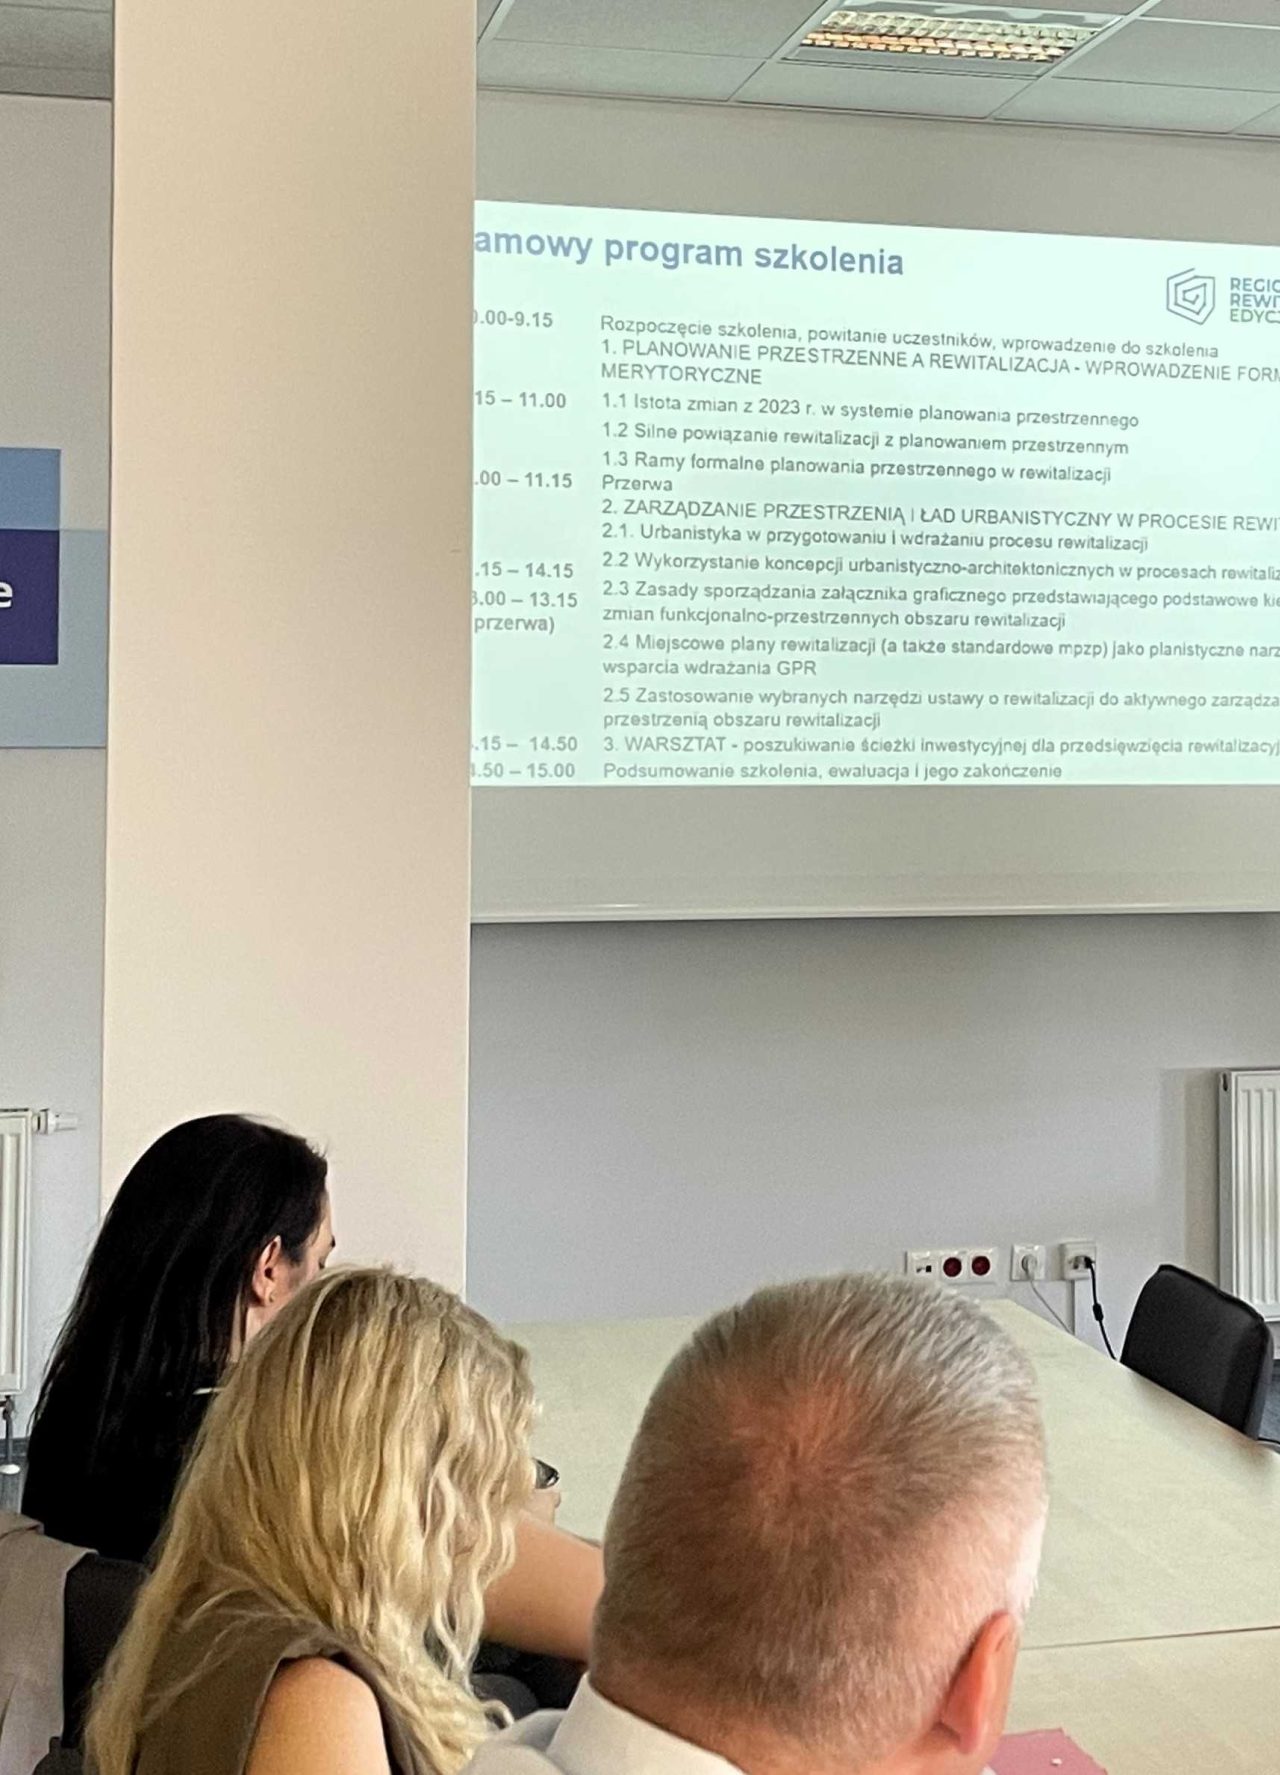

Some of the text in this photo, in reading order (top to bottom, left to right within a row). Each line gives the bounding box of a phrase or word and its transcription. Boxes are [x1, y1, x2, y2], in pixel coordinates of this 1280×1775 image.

[475, 232, 904, 276] amowy program szkolenia
[600, 316, 1219, 359] Rozpoczęcie szkolenia, powitanie uczestników, wprowadzenie do szkolenia
[602, 340, 617, 356] 1.
[622, 340, 751, 361] PLANOWANIE
[757, 346, 908, 368] PRZESTRZENNE
[911, 352, 925, 368] A
[929, 353, 1071, 374] REWITALIZACJA
[1085, 360, 1231, 381] WPROWADZENIE
[601, 363, 762, 385] MERYTORYCZNE
[519, 391, 567, 409] 11.00
[603, 393, 1139, 430] 1.1 Istota zmian z 2023 r. w systemie planowania przestrzennego
[603, 422, 1129, 458] 1.2 Silne powiązanie rewitalizacji z planowaniem przestrzennym
[603, 451, 1111, 485] 1.3 Ramy formalne planowania przestrzennego w rewitalizacji
[524, 471, 573, 489] 11.15
[602, 475, 673, 492] Przerwa
[601, 499, 617, 515] 2.
[623, 500, 757, 520] ZARZĄDZANIE
[763, 503, 906, 525] PRZESTRZENIĄ
[910, 507, 915, 523] I
[919, 507, 956, 524] ŁAD
[961, 508, 1113, 528] URBANISTYCZNY
[1116, 512, 1134, 528] W
[1138, 513, 1227, 531] PROCESIE
[602, 522, 634, 538] 2.1.
[640, 523, 742, 544] Urbanistyka
[746, 529, 761, 542] w
[766, 528, 887, 546] przygotowaniu
[900, 530, 984, 548] wdrażaniu
[988, 535, 1053, 551] procesu
[1057, 534, 1149, 554] rewitalizacji
[525, 562, 574, 578] 14.15
[602, 552, 629, 568] 2.2
[634, 552, 760, 572] Wykorzystanie
[764, 555, 844, 575] koncepcji
[848, 557, 1115, 580] urbanistyczno-architektonicznych
[1118, 565, 1133, 578] w
[1136, 564, 1217, 581] procesach
[529, 591, 578, 609] 13.15
[602, 581, 630, 597] 2.3
[635, 581, 699, 601] Zasady
[703, 583, 816, 602] sporządzania
[821, 585, 908, 604] załącznika
[912, 586, 1007, 606] graficznego
[1012, 588, 1159, 609] przedstawiającego
[1162, 591, 1259, 609] podstawowe
[474, 616, 556, 635] przerwa)
[602, 605, 1066, 631] zmian funkcjonalno-przestrzennych obszaru rewitalizacji
[603, 634, 629, 649] 2.4
[635, 634, 725, 653] Miejscowe
[730, 635, 776, 654] plany
[780, 636, 876, 656] rewitalizacji
[880, 637, 898, 656] (a
[902, 638, 946, 654] także
[951, 639, 1054, 655] standardowe
[1058, 640, 1108, 659] mpzp)
[1112, 640, 1145, 659] jako
[1149, 641, 1245, 660] planistyczne
[602, 658, 817, 677] wsparcia wdrażania GPR
[603, 687, 630, 703] 2.5
[635, 687, 754, 704] Zastosowanie
[758, 688, 848, 707] wybranych
[853, 689, 923, 708] narzędzi
[927, 690, 985, 708] ustawy
[988, 693, 1000, 705] o
[1003, 690, 1095, 709] rewitalizacji
[1099, 691, 1119, 706] do
[1123, 691, 1207, 710] aktywnego
[603, 711, 881, 730] przestrzenią obszaru rewitalizacji
[529, 735, 578, 751] 14.50
[603, 736, 618, 752] 3.
[624, 736, 727, 752] WARSZTAT
[743, 737, 856, 755] poszukiwanie
[860, 737, 916, 752] ścieżki
[920, 737, 1027, 756] inwestycyjnej
[1031, 737, 1055, 753] dla
[1059, 737, 1183, 756] przedsięwzięcia
[526, 763, 576, 779] 15.00
[603, 763, 735, 779] Podsumowanie
[740, 763, 823, 781] szkolenia,
[827, 763, 910, 781] ewaluacja
[924, 763, 959, 781] jego
[962, 763, 1063, 778] zakończenie
